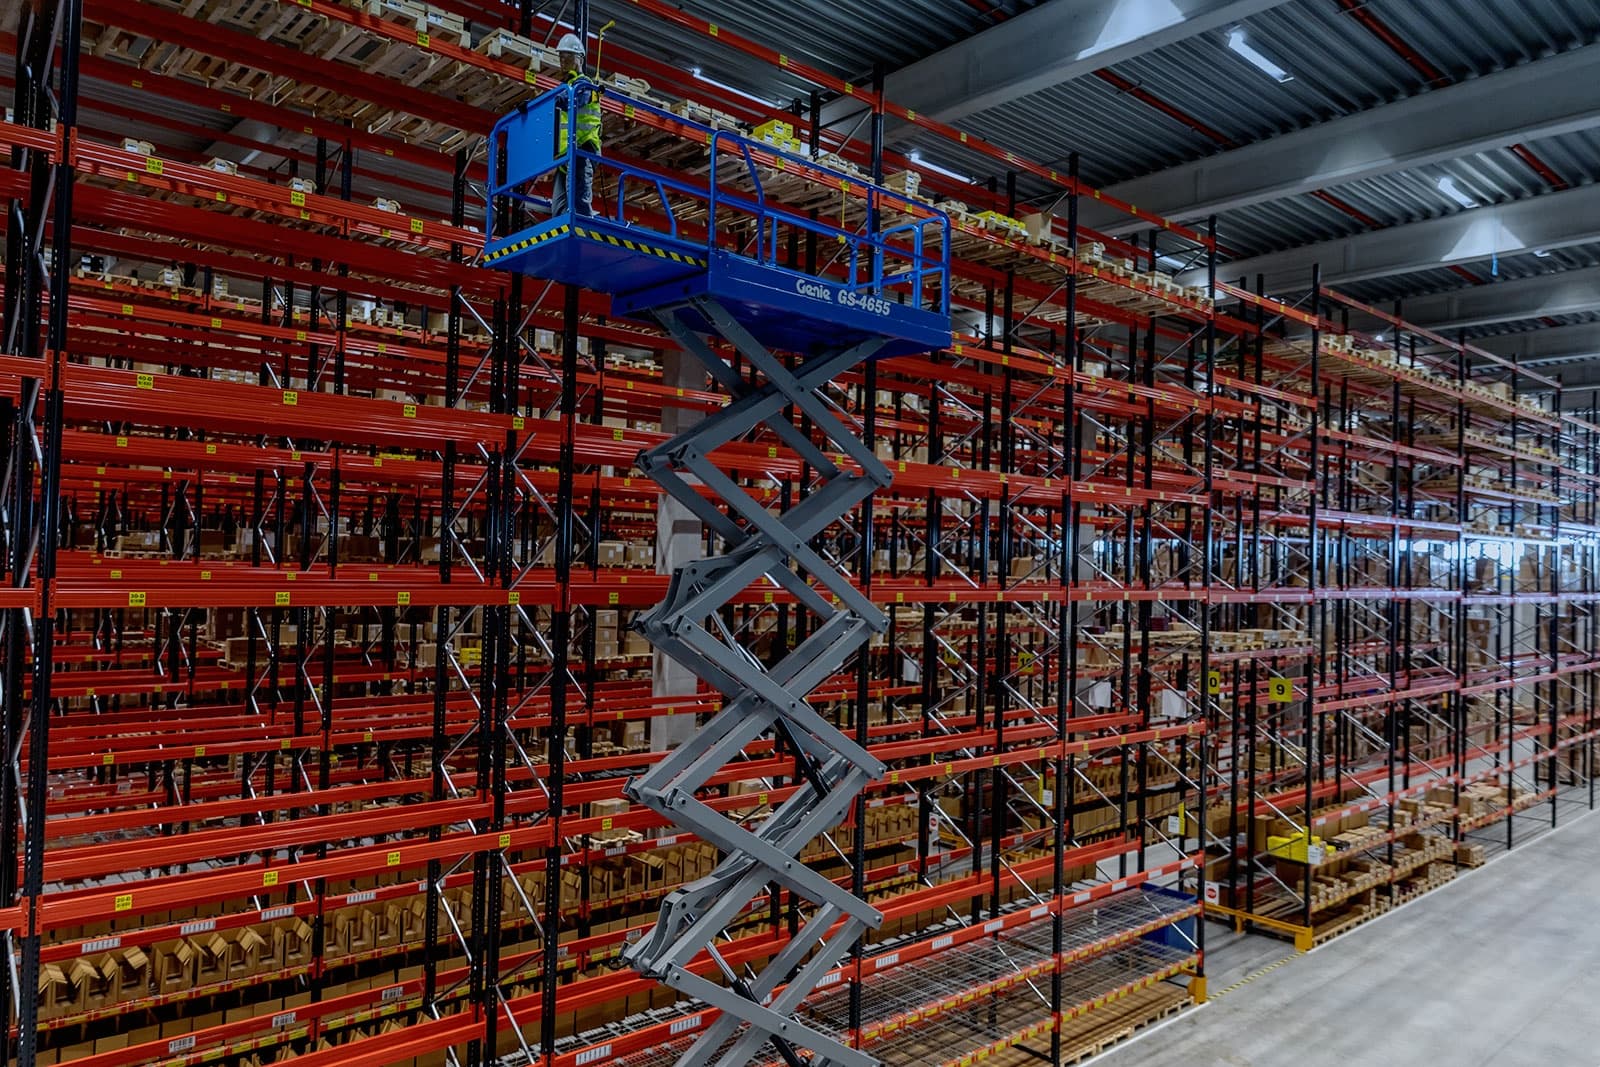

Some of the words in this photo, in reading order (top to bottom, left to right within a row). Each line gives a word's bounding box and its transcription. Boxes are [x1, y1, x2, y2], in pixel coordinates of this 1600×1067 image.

[796, 279, 831, 300] Genie
[837, 289, 891, 316] GS-4655
[1275, 684, 1285, 695] 9
